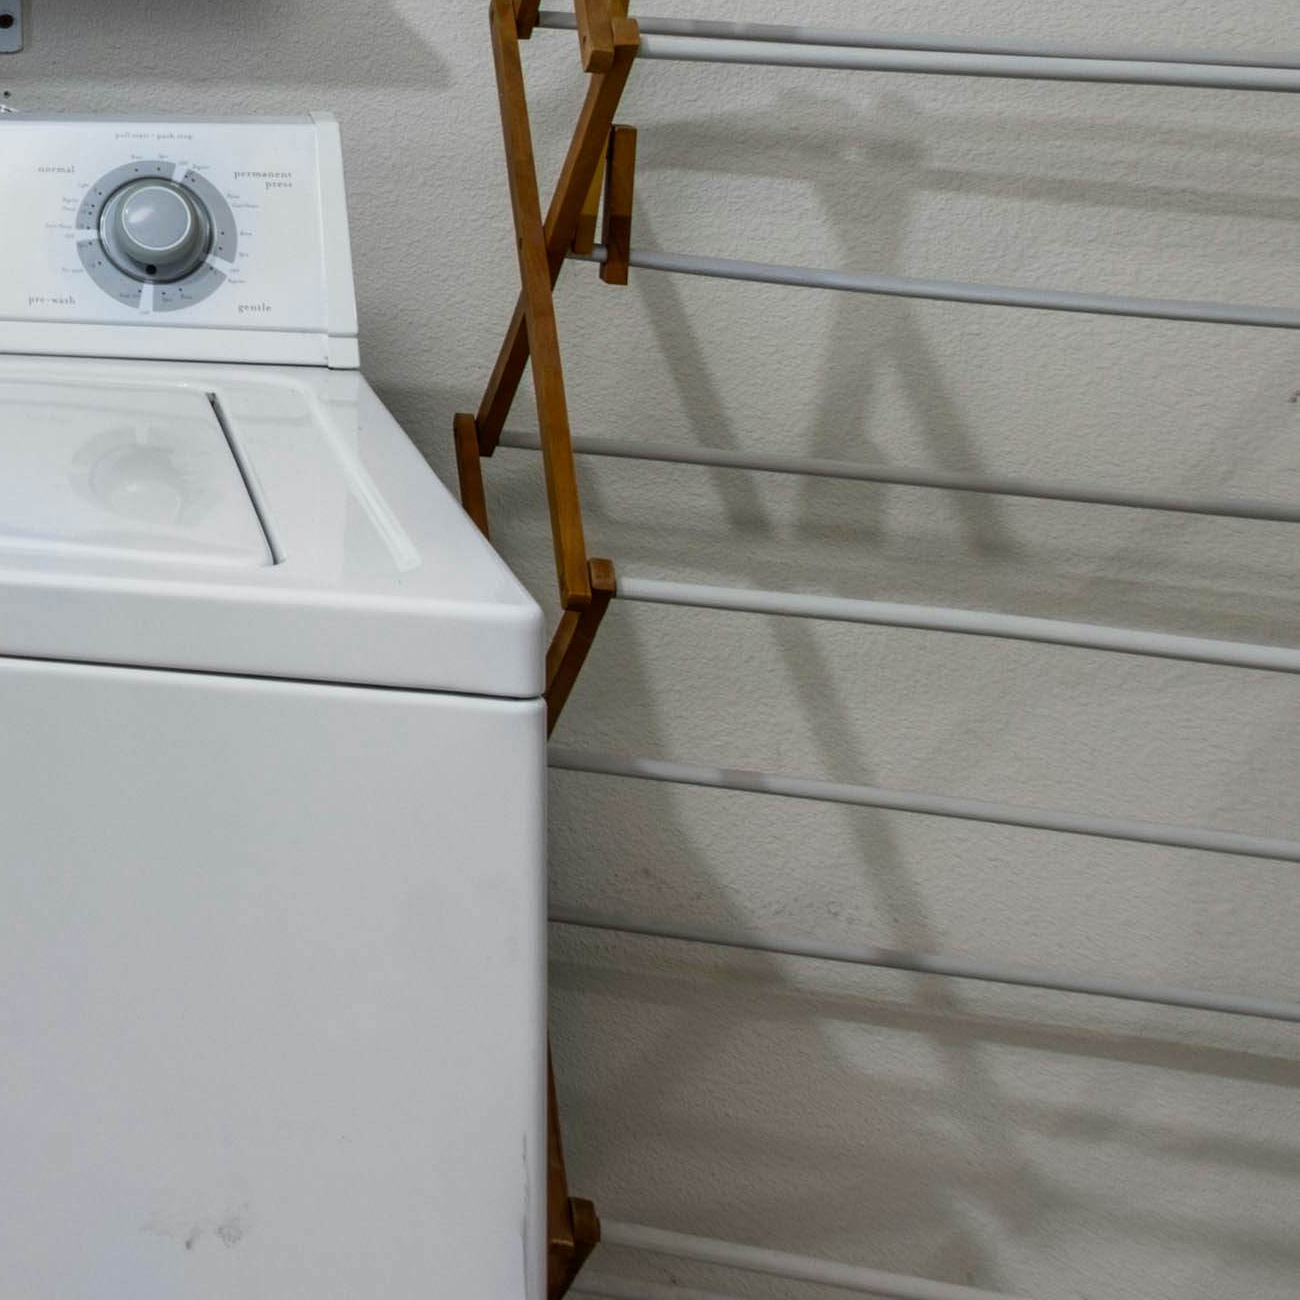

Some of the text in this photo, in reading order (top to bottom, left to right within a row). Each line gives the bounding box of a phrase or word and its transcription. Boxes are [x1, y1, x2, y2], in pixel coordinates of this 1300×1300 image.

[38, 165, 76, 173] normal
[234, 171, 293, 180] permanent
[265, 181, 293, 190] press
[29, 295, 76, 306] pre-wash
[237, 302, 272, 313] gentle
